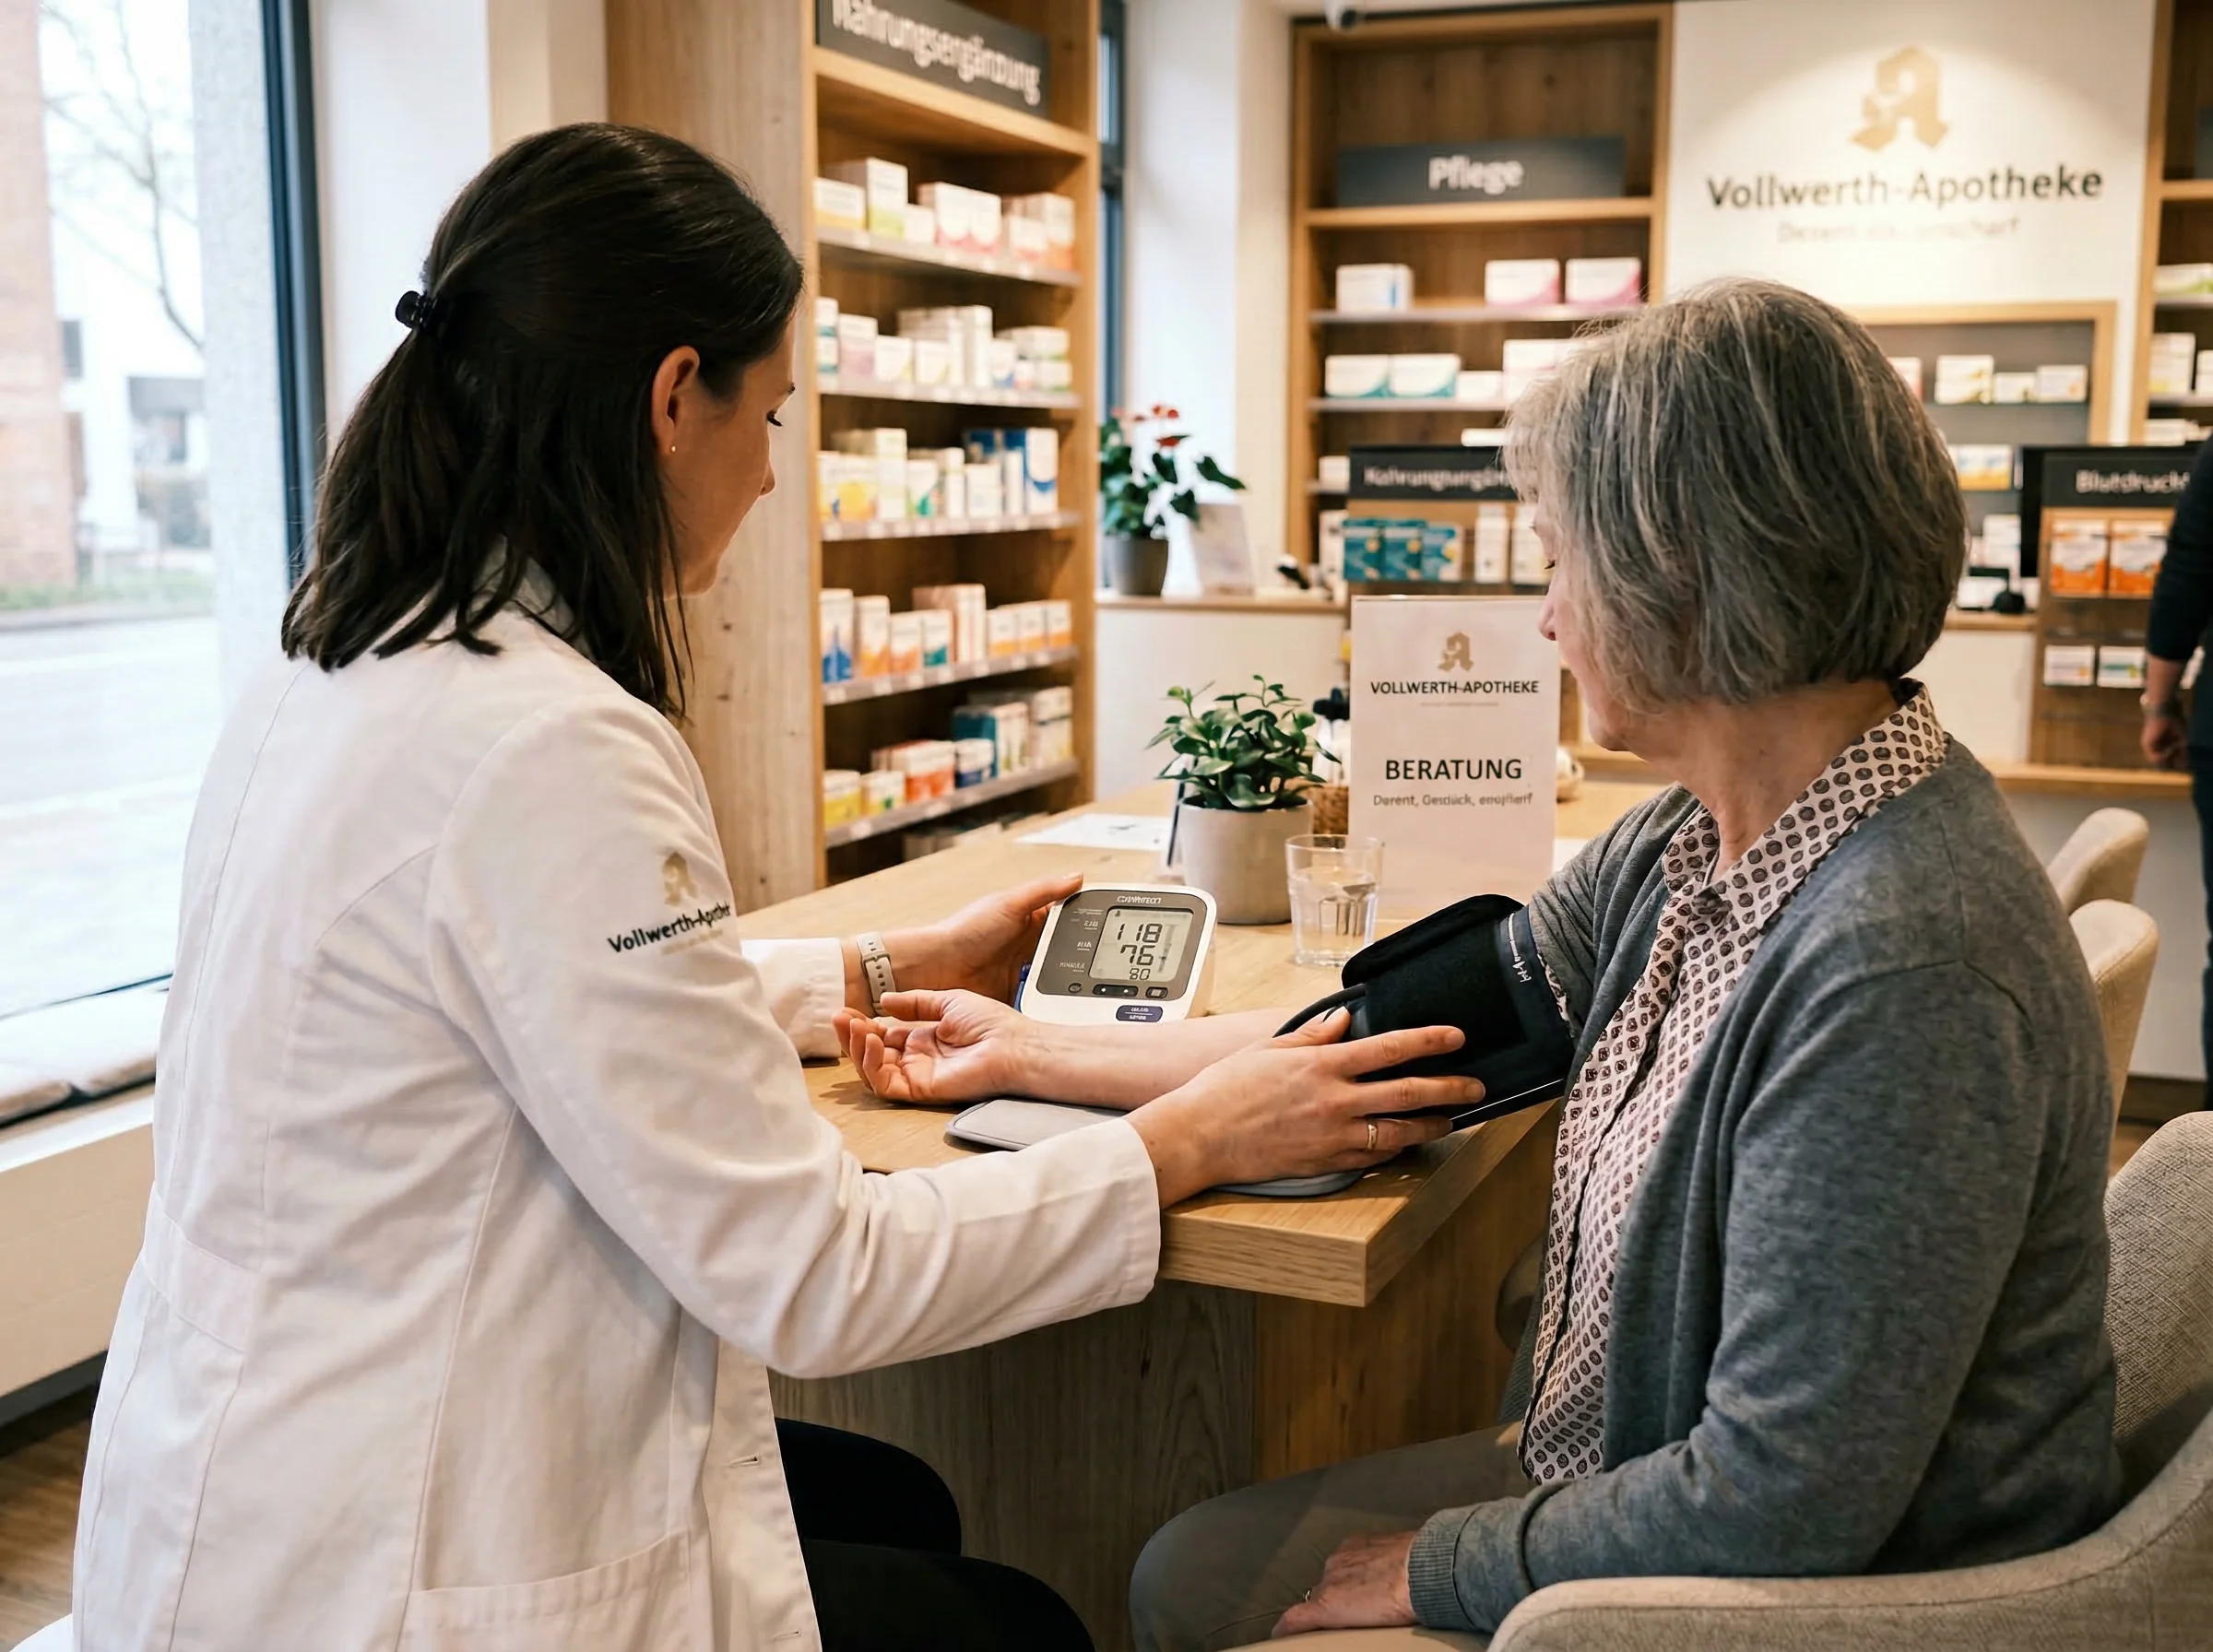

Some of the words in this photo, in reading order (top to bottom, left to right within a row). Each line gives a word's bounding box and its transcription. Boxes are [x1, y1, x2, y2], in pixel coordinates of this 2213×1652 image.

[1428, 153, 1524, 195] Pflege
[1707, 163, 2103, 210] Vollwerth-Apotheke
[1370, 680, 1540, 694] VOLLWERTH-APOTHEKE
[1385, 759, 1522, 780] BERATUNG
[1117, 923, 1163, 943] 118
[1119, 944, 1155, 966] 76
[1129, 967, 1152, 981] 80
